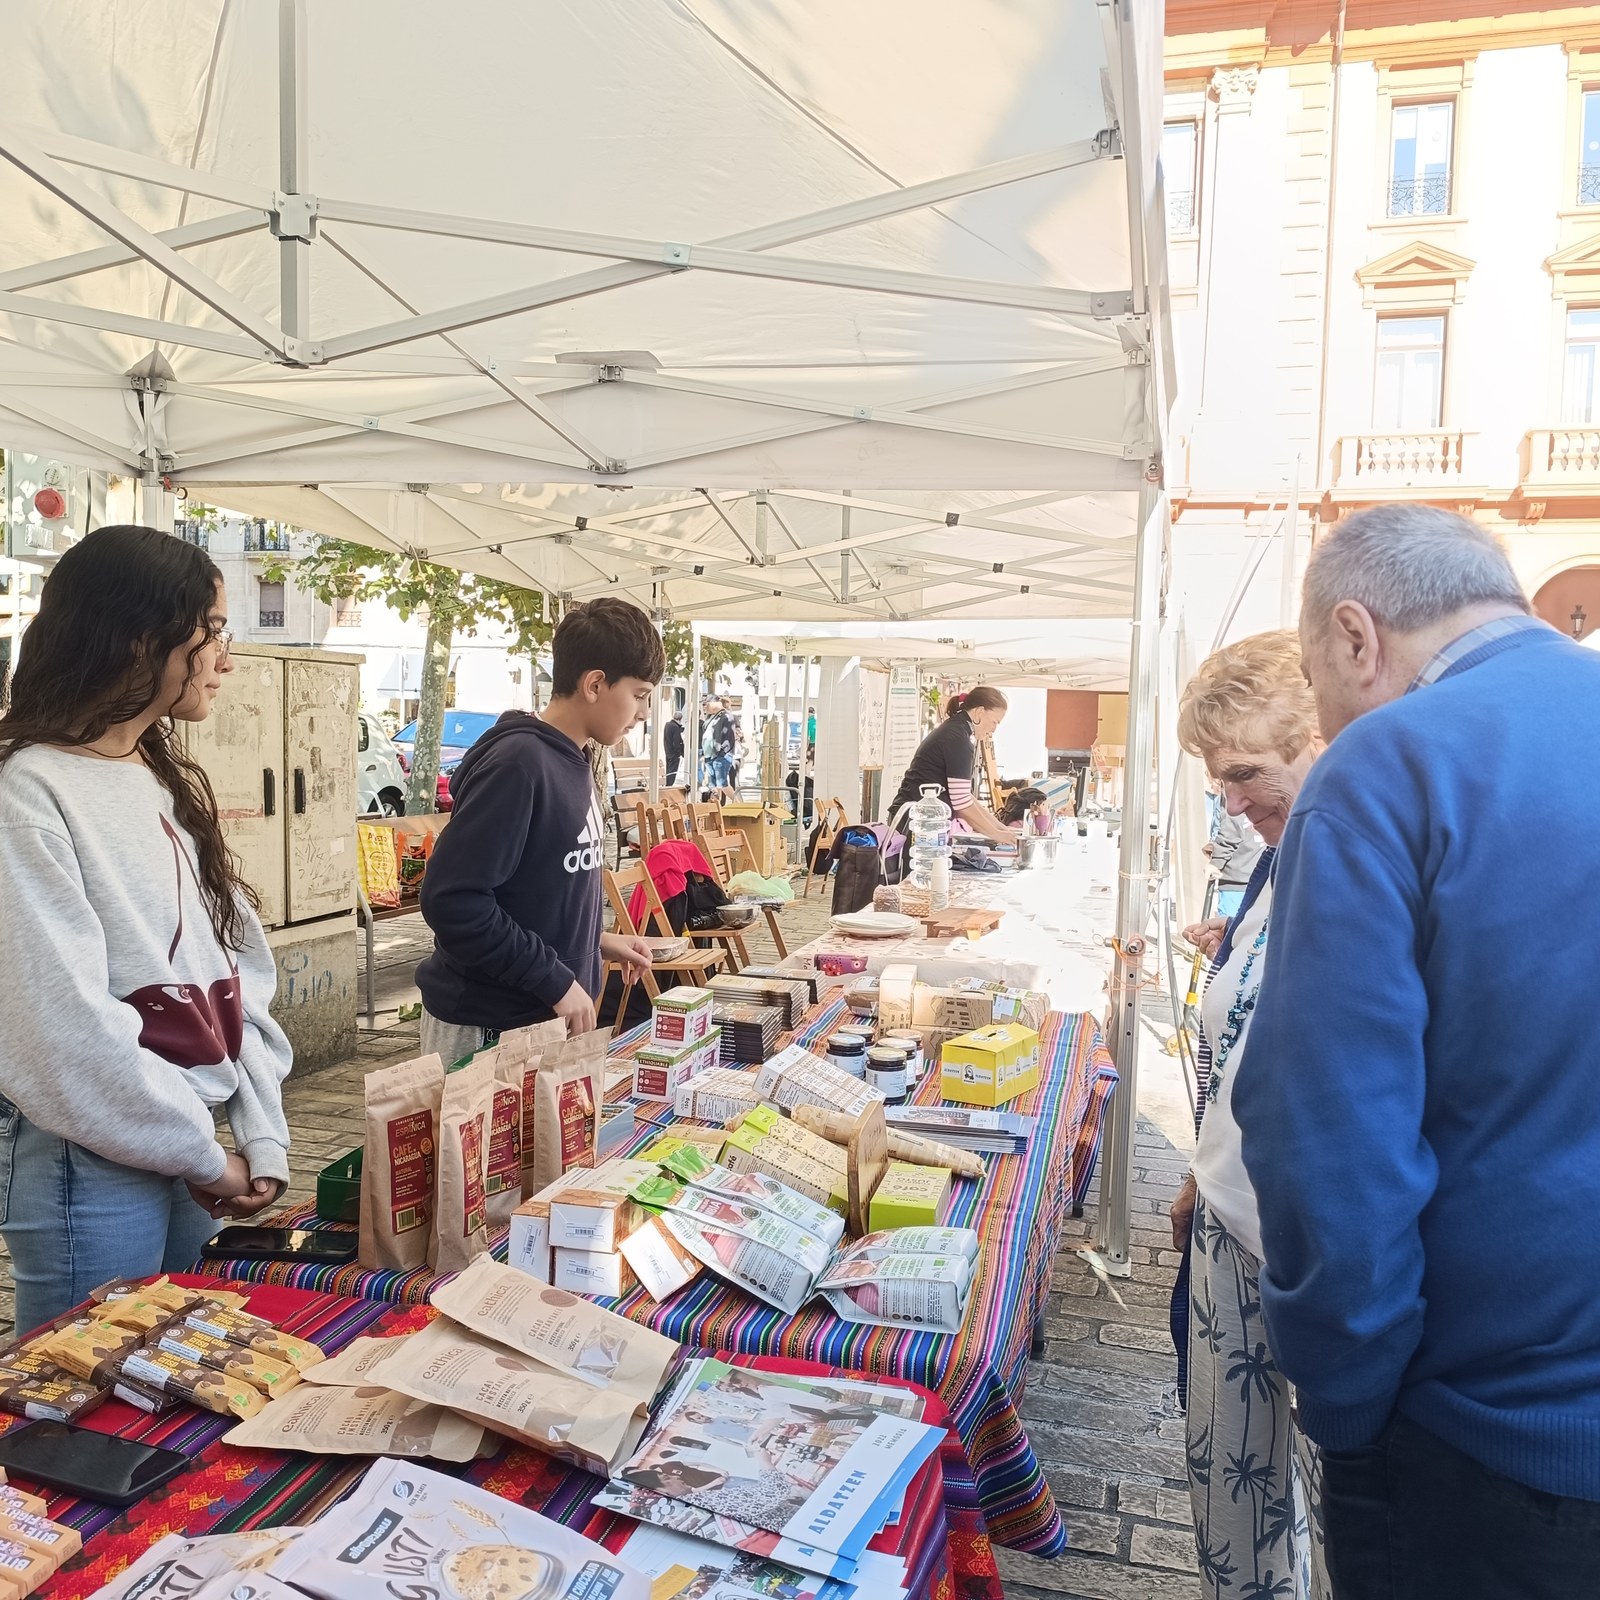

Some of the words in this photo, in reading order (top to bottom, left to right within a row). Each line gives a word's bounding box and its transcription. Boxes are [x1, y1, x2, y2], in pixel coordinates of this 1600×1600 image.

[657, 1005, 687, 1014] ETHIQUABLE
[639, 1059, 669, 1068] ETHIQUABLE
[394, 1151, 421, 1166] NICARAGUA
[477, 1285, 509, 1317] eathica
[528, 1319, 544, 1338] CACAO
[189, 1337, 209, 1348] crisp
[210, 1339, 231, 1349] choc
[158, 1357, 179, 1368] crisp
[422, 1347, 463, 1380] eathica
[476, 1380, 494, 1401] CACAO
[282, 1395, 323, 1433] eathica
[337, 1416, 355, 1435] CACAO
[808, 1470, 867, 1534] ALDATZEN
[572, 1562, 600, 1597] CIOCCOLATO
